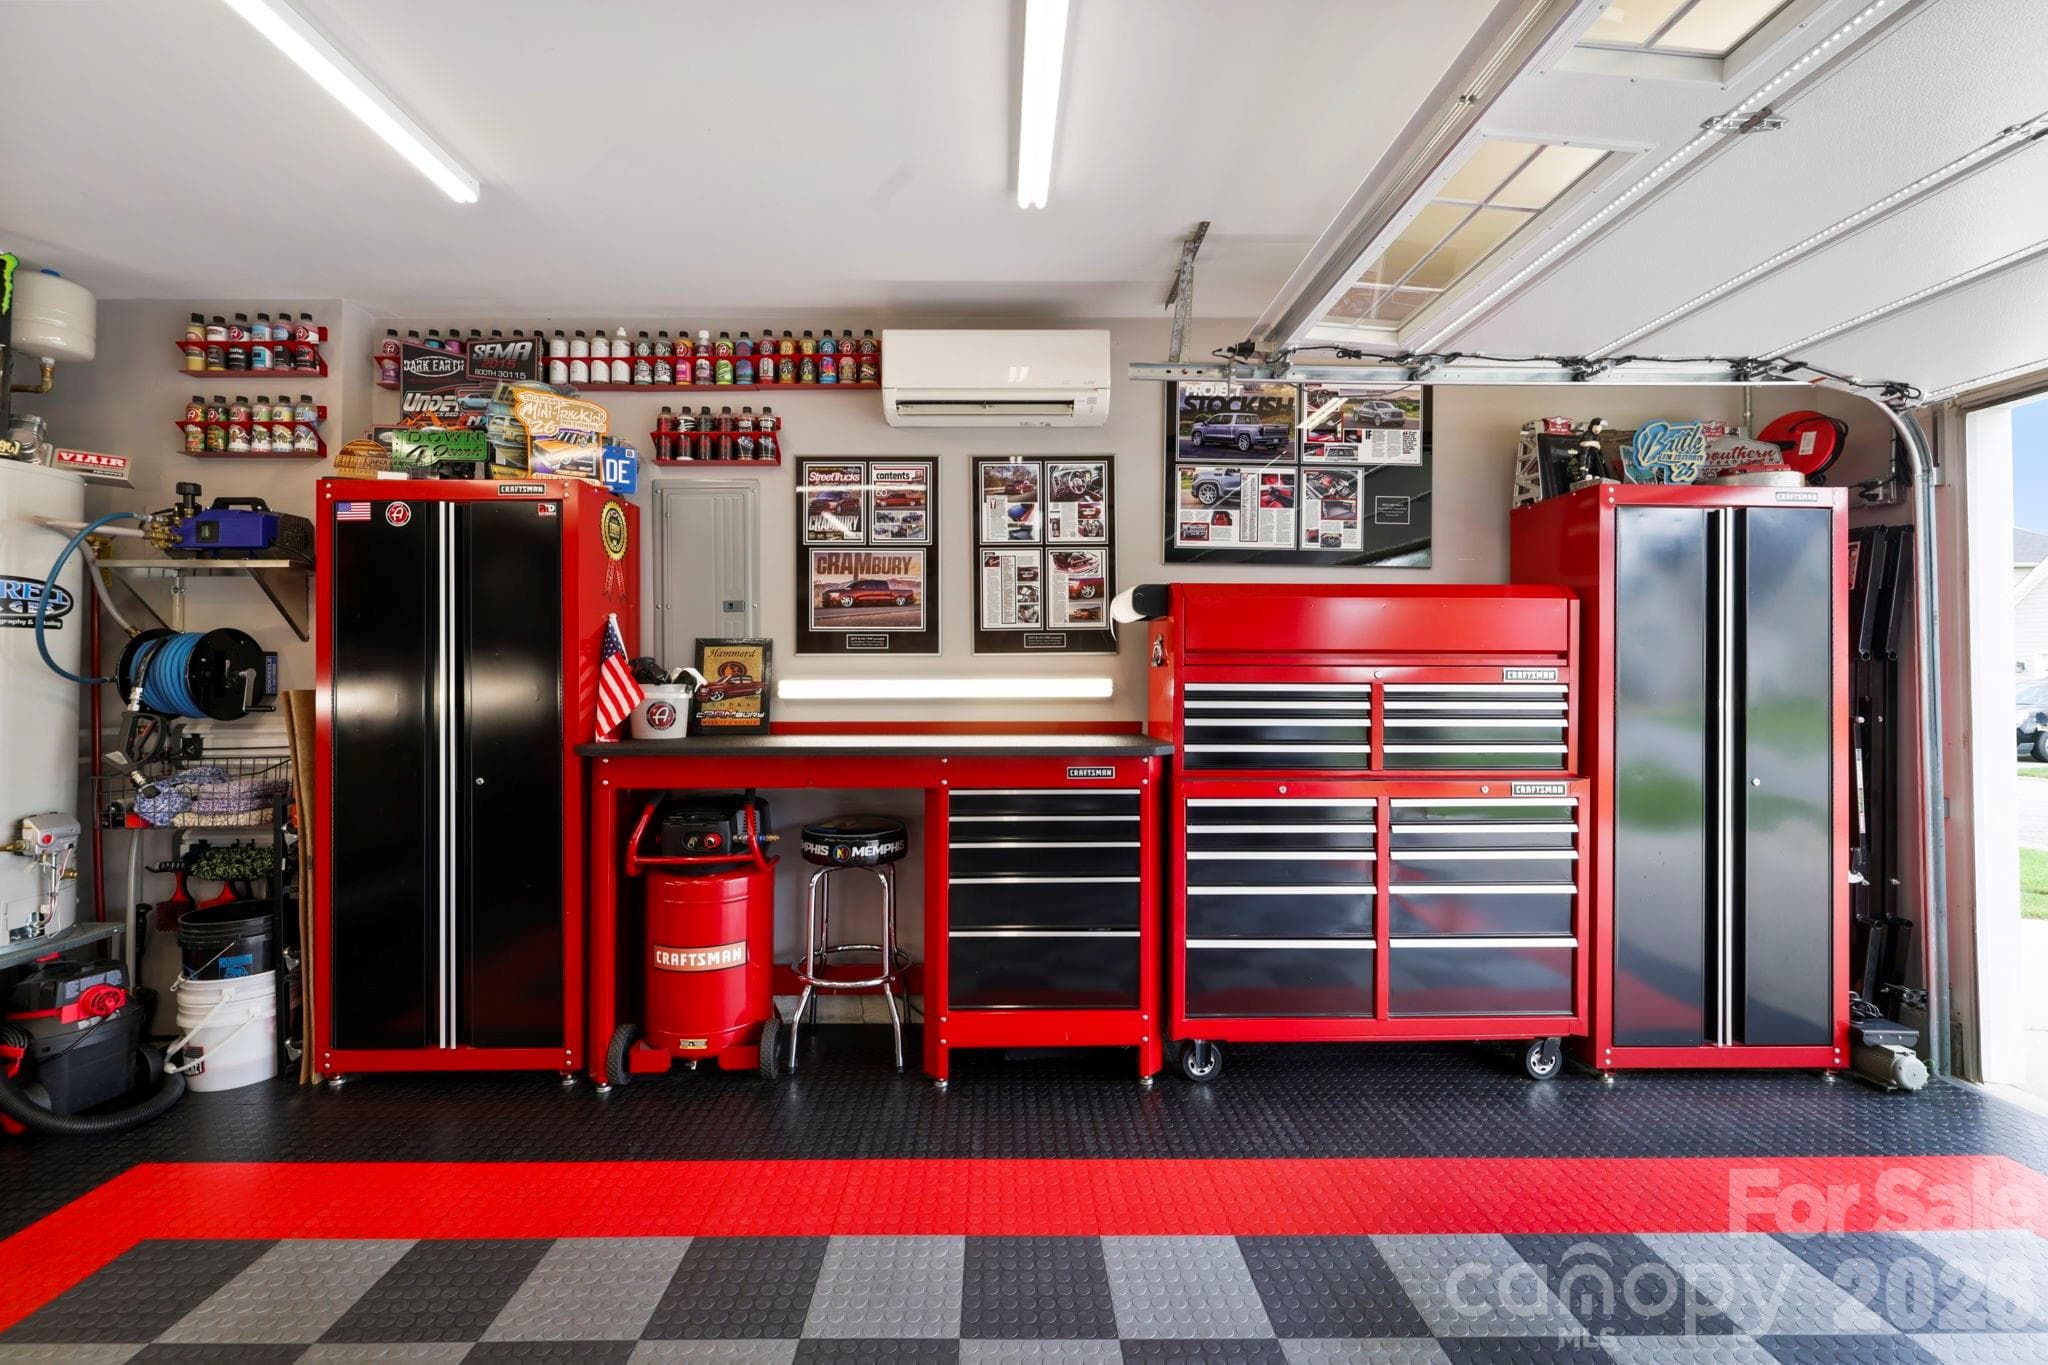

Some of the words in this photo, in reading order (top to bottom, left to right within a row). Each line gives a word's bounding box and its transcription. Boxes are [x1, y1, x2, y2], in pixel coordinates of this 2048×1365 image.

[473, 341, 533, 360] SEMA
[404, 360, 428, 371] DARK
[433, 360, 464, 371] EARTH
[475, 368, 496, 377] BOOTH
[498, 371, 527, 380] 30115
[1184, 396, 1295, 412] STOCKISH
[408, 431, 481, 445] DOWN
[1640, 424, 1703, 465] Battle
[60, 452, 124, 467] VIAIR
[602, 458, 630, 484] DE
[876, 472, 910, 480] contents
[500, 485, 544, 493] CRAFTSMAN
[1507, 671, 1554, 680] CRAFTSMAN
[1070, 769, 1112, 777] CRAFTSMAN
[1515, 785, 1564, 794] CRAFTSMAN
[851, 840, 905, 857] MEMPHIS
[655, 947, 742, 967] CRAFTSMAN
